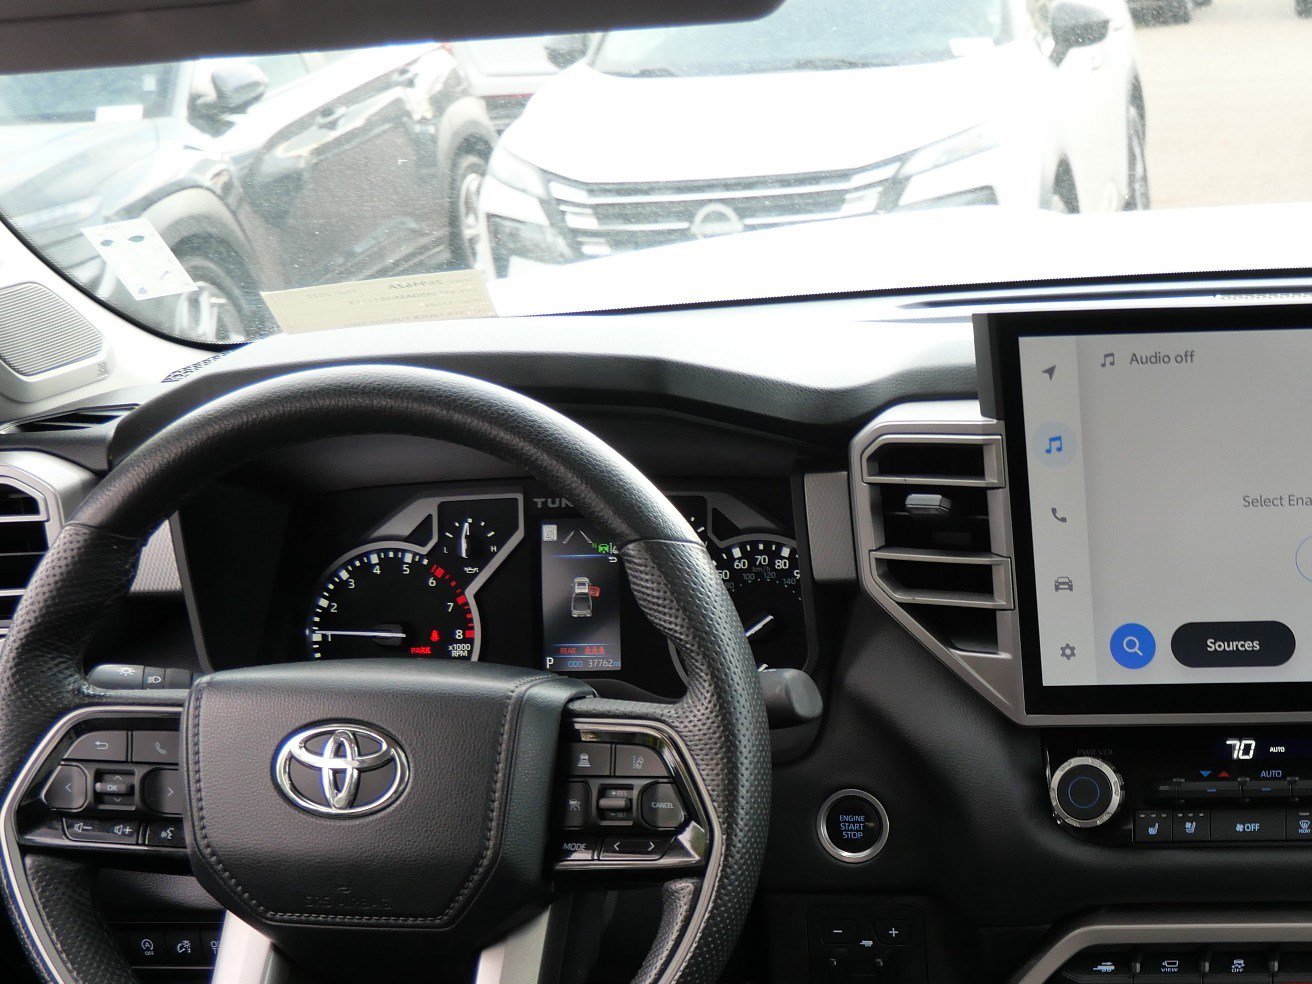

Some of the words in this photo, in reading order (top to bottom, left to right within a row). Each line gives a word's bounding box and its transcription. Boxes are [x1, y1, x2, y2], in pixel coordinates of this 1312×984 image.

[1129, 352, 1171, 365] Audio
[1174, 351, 1195, 364] off
[1242, 494, 1284, 508] Select
[734, 559, 748, 569] 60
[755, 555, 769, 566] 70
[775, 559, 789, 569] 80
[372, 565, 382, 575] 4
[403, 564, 411, 574] 5
[348, 579, 356, 589] 3
[428, 577, 437, 587] 6
[330, 603, 339, 613] 2
[447, 602, 455, 613] 7
[455, 629, 464, 640] 8
[448, 643, 471, 651] x1000
[1206, 638, 1260, 652] Sources
[410, 647, 432, 655] PARK
[546, 657, 554, 669] P
[1226, 738, 1256, 760] 70
[1260, 769, 1282, 778] AUTO
[106, 783, 119, 792] OK
[650, 801, 675, 809] CANCEL
[839, 814, 865, 822] ENGINE
[840, 823, 864, 831] START
[1244, 822, 1260, 832] OFF
[842, 831, 864, 839] STOP
[562, 842, 587, 852] MODE
